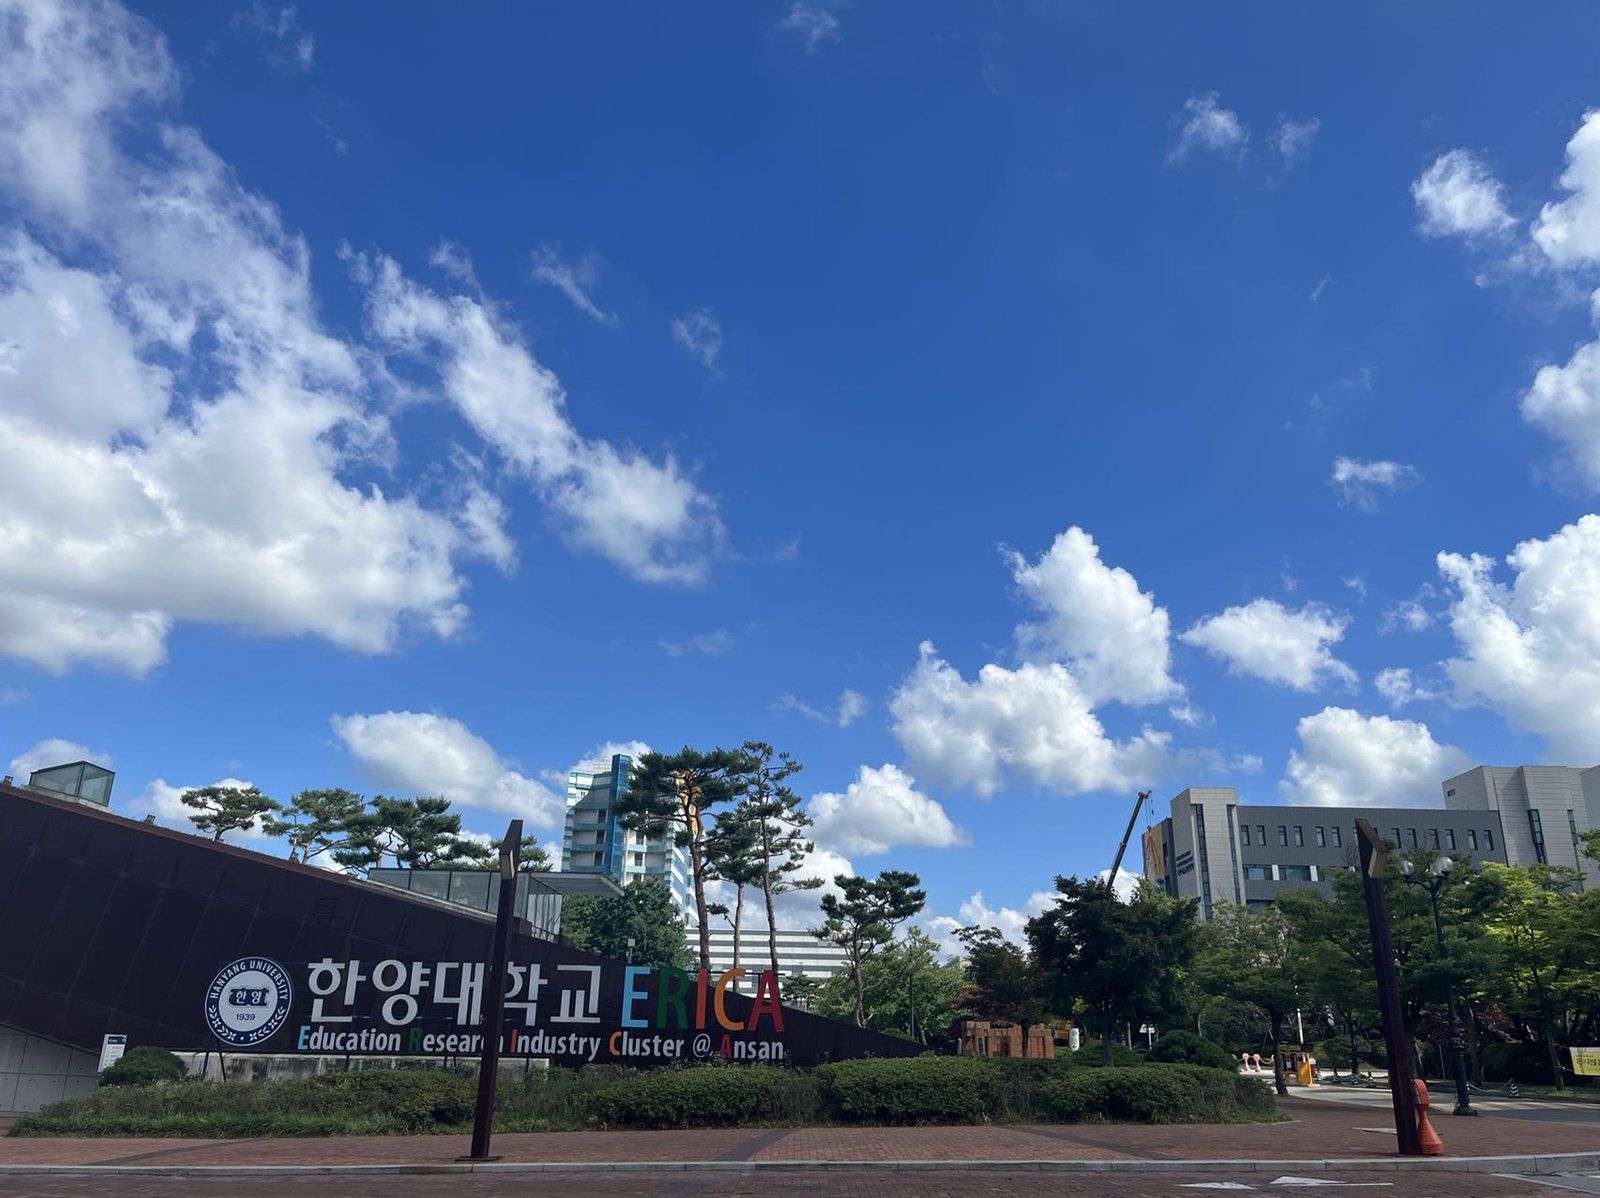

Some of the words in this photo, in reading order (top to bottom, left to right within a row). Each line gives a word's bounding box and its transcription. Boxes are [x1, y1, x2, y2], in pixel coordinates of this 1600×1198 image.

[210, 962, 246, 999] HANYANG
[249, 961, 288, 1000] UNIVERSITY
[236, 990, 262, 1005] 한양
[621, 965, 784, 1033] ERICA
[236, 1013, 256, 1021] 1939
[297, 1025, 401, 1051] Education
[408, 1027, 504, 1053] Resear
[510, 1028, 601, 1062] Industry
[609, 1031, 684, 1057] Cluster
[692, 1033, 711, 1058] @
[719, 1034, 784, 1060] Ansan
